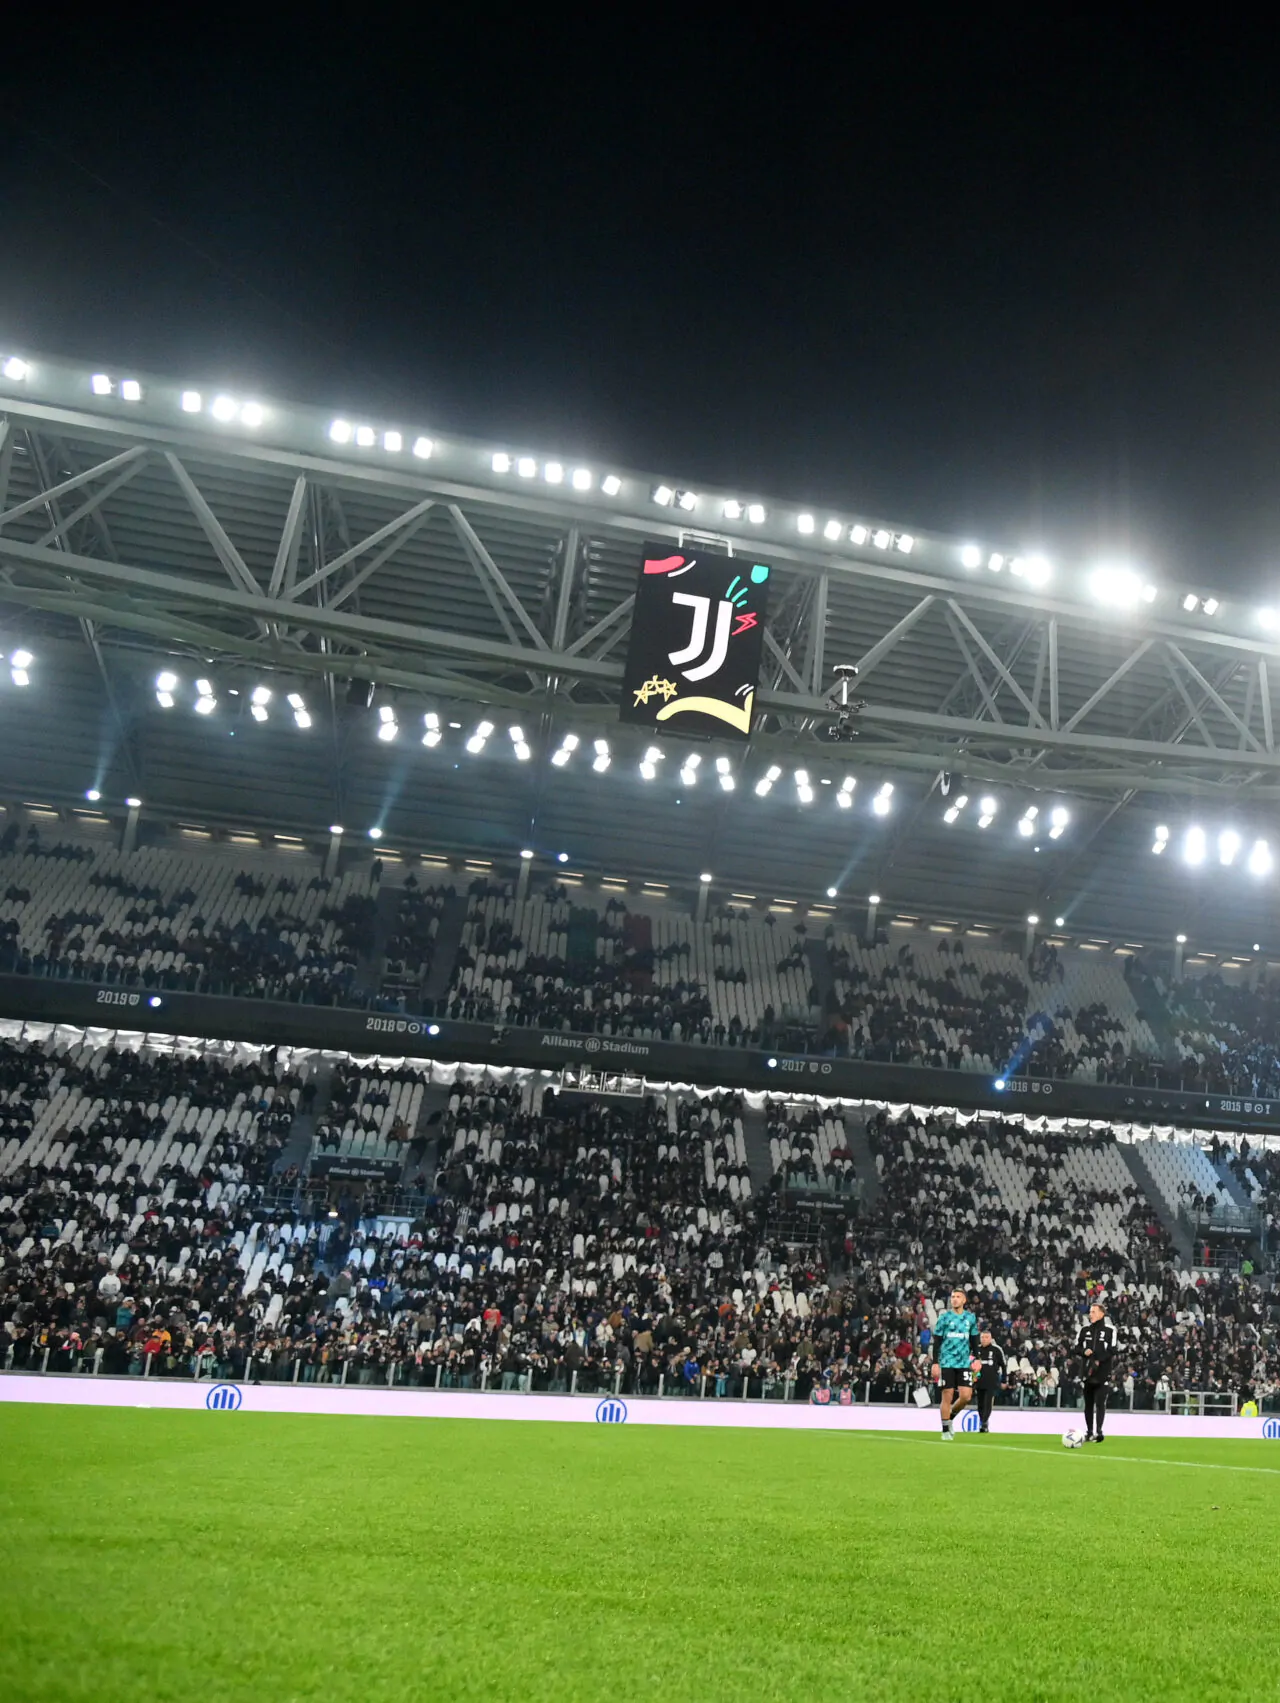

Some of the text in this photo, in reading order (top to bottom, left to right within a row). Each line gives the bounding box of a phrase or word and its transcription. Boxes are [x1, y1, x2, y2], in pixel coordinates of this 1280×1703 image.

[96, 990, 128, 1006] 2019
[366, 1017, 395, 1032] 2018
[541, 1034, 650, 1055] Allianz Stadium
[781, 1060, 806, 1073] 2017
[1220, 1100, 1242, 1112] 2015
